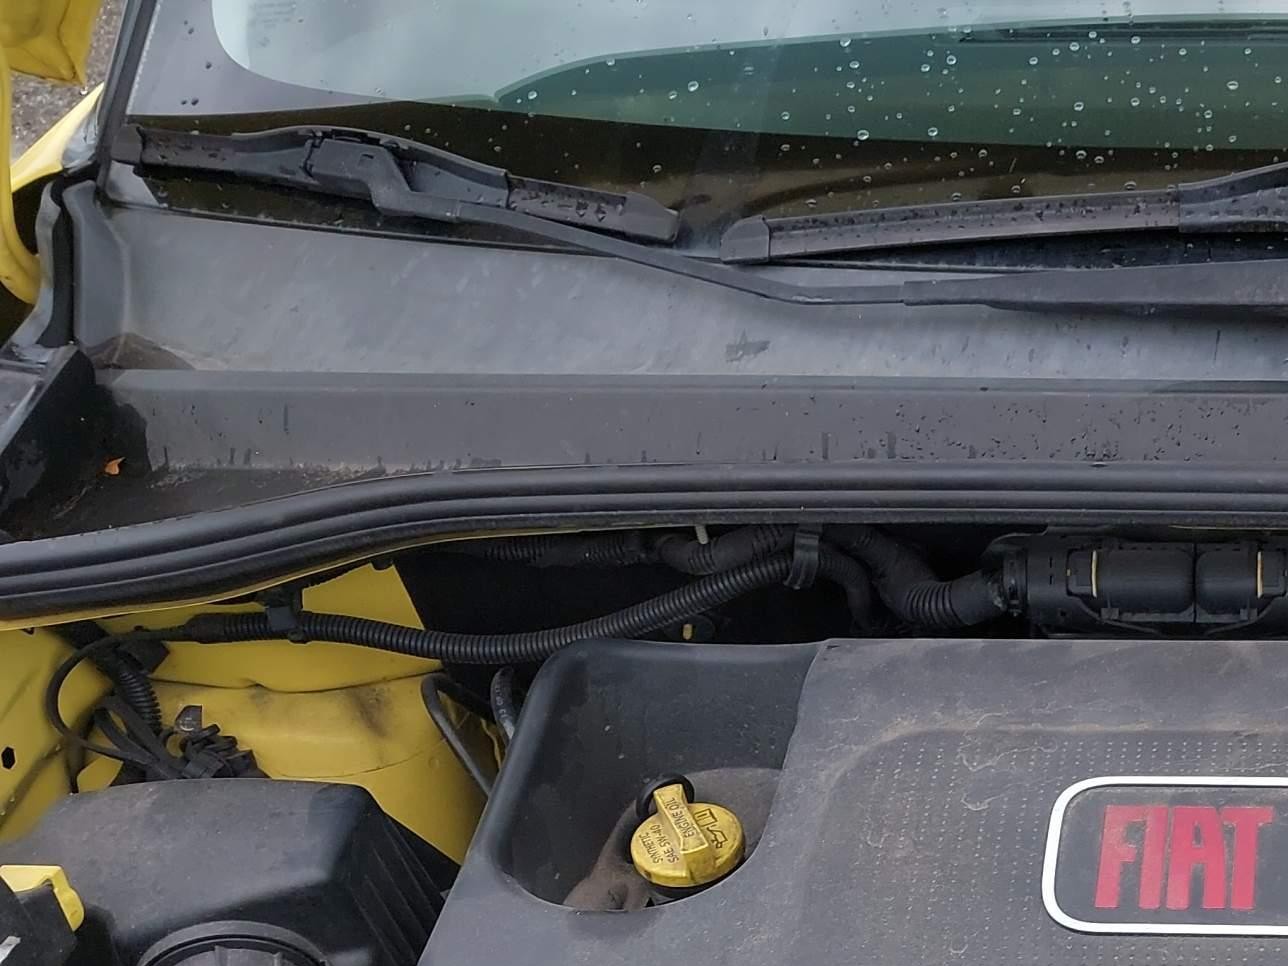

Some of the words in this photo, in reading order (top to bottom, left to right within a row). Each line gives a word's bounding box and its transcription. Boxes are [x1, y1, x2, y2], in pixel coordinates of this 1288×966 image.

[664, 797, 681, 812] OIL
[650, 824, 669, 848] 5W-40
[672, 811, 695, 838] ENGINE
[639, 832, 664, 864] SYNTHETIC
[664, 845, 680, 864] SAE
[1094, 804, 1275, 909] FIAT
